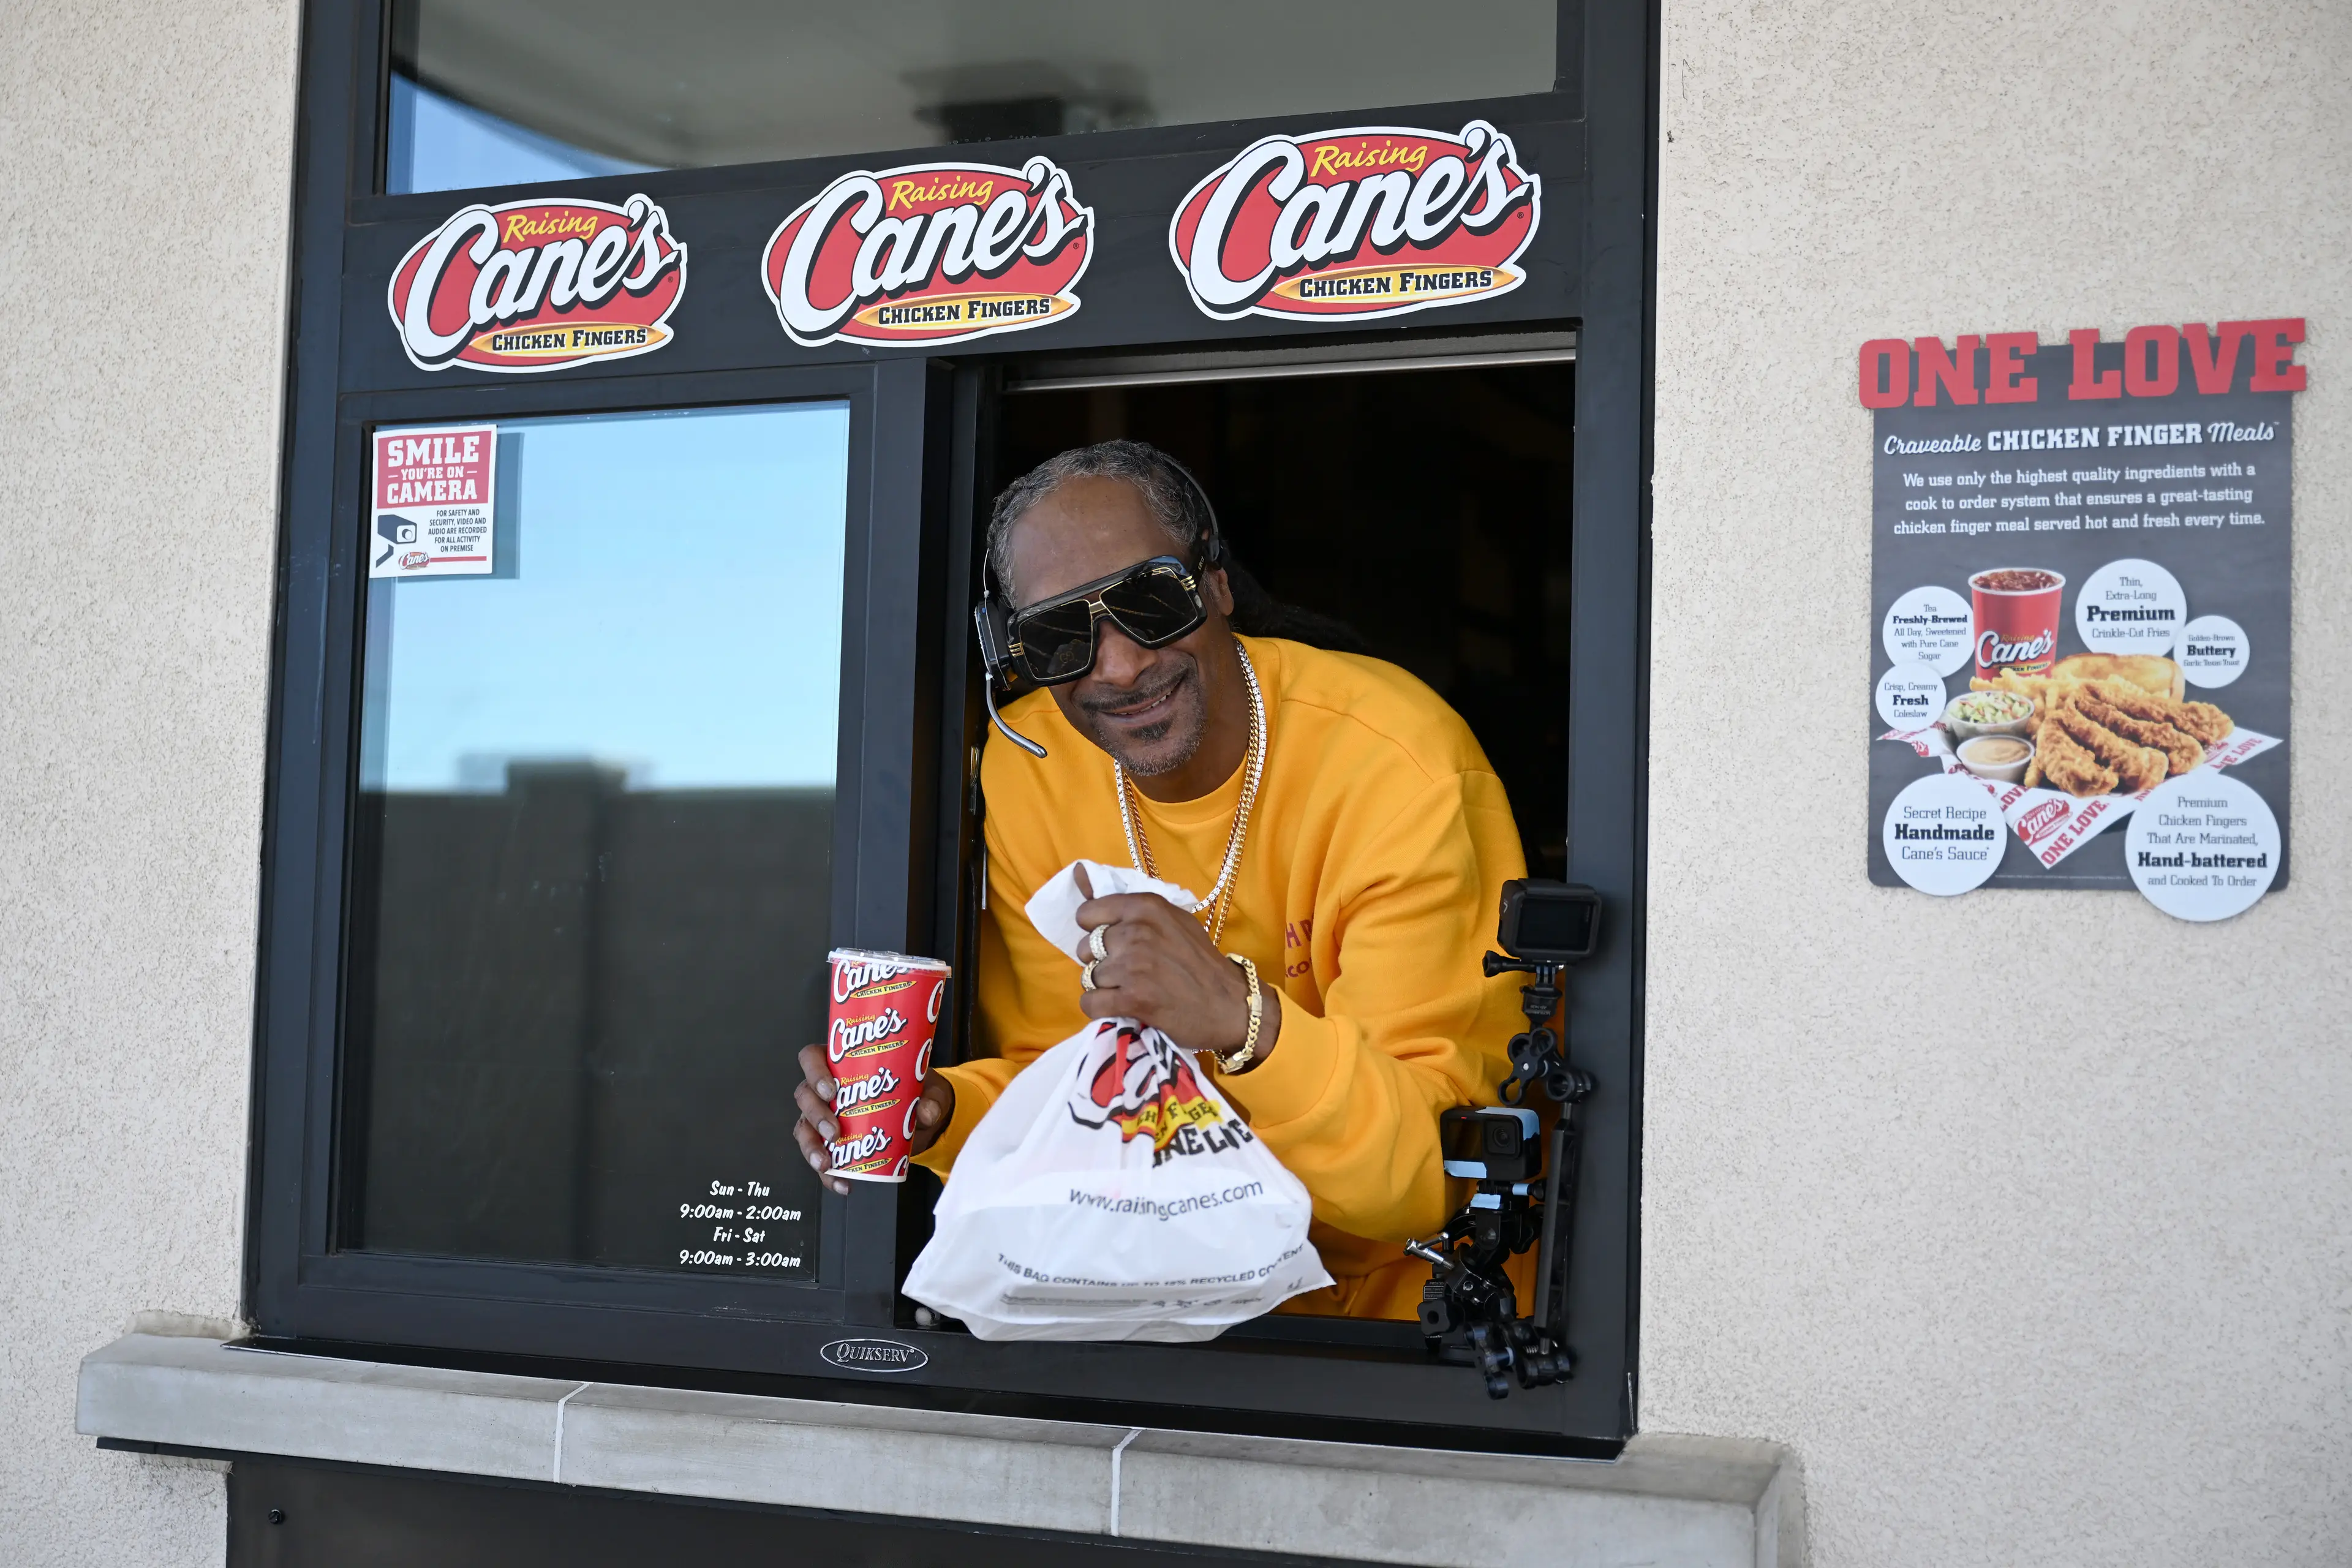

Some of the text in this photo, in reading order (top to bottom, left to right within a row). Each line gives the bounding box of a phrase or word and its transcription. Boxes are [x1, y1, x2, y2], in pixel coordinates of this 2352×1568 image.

[1311, 140, 1428, 177] Raising
[889, 175, 994, 211] Raising
[503, 211, 598, 243] Raising
[1189, 127, 1533, 311] Cane's
[780, 163, 1086, 336] Cane's
[404, 200, 680, 360] Cane's
[1300, 270, 1493, 298] CHICKEN FINGERS
[878, 298, 1050, 325] CHICKEN FINGERS
[492, 328, 647, 352] CHICKEN FINGERS
[1858, 317, 2307, 409] ONE LOVE
[1884, 432, 1982, 455] Craveable
[1988, 427, 2100, 451] CHICKEN
[2108, 423, 2203, 447] FINGER
[388, 435, 480, 467] SMILE
[401, 466, 464, 480] YOU'RE ON
[1903, 462, 2256, 488] We use only the highest quality ingredients with a
[387, 479, 477, 504] CAMERA
[1905, 488, 2254, 511] cook to order system that ensures a great-tasting
[1894, 511, 2265, 536] chicken finger meal served hot and fresh every time.
[1923, 604, 1937, 612] Tea
[2087, 605, 2176, 622] Premium
[1893, 614, 1968, 625] Freshly-Brewed
[1894, 628, 1905, 636] All
[1925, 627, 1967, 636] Sweetened
[2092, 627, 2171, 638] Crinkle-Cut Fries
[1940, 639, 1959, 647] Cane
[1977, 628, 2054, 669] Cane's
[2187, 644, 2236, 658] Buttery
[1918, 651, 1941, 662] Sugar
[1909, 682, 1938, 692] Creamy
[1893, 694, 1929, 706] Fresh
[1894, 709, 1928, 718] Coleslaw
[2177, 796, 2228, 808] Premium
[1904, 806, 1987, 822] Secret Recipe
[2158, 814, 2247, 829] Chicken Fingers
[1894, 823, 1995, 841] Handmade
[2041, 832, 2075, 865] ONE
[2068, 799, 2108, 836] LOVE
[2147, 832, 2259, 846] That Are Marinated,
[1902, 846, 1943, 860] Cane's
[2138, 851, 2267, 869] Hand-battered
[2147, 875, 2258, 887] and Cooked To Order
[856, 988, 882, 998] CHICKEN
[845, 1014, 876, 1027] Raising
[829, 1008, 908, 1063] Cane's
[850, 1047, 876, 1057] CHICKEN
[840, 1072, 870, 1086] Raising
[824, 1126, 892, 1169] ane's
[709, 1180, 734, 1197] Sun
[747, 1182, 771, 1197] Thu
[679, 1203, 734, 1219] 9:00am
[745, 1205, 801, 1221] 2:00am
[713, 1226, 733, 1243] Fri
[742, 1227, 766, 1243] Sat
[679, 1249, 733, 1266] 9:00am
[745, 1251, 801, 1268] 3:00am
[1190, 1270, 1256, 1285] RECYCLED
[836, 1343, 908, 1363] QUIKSERV
